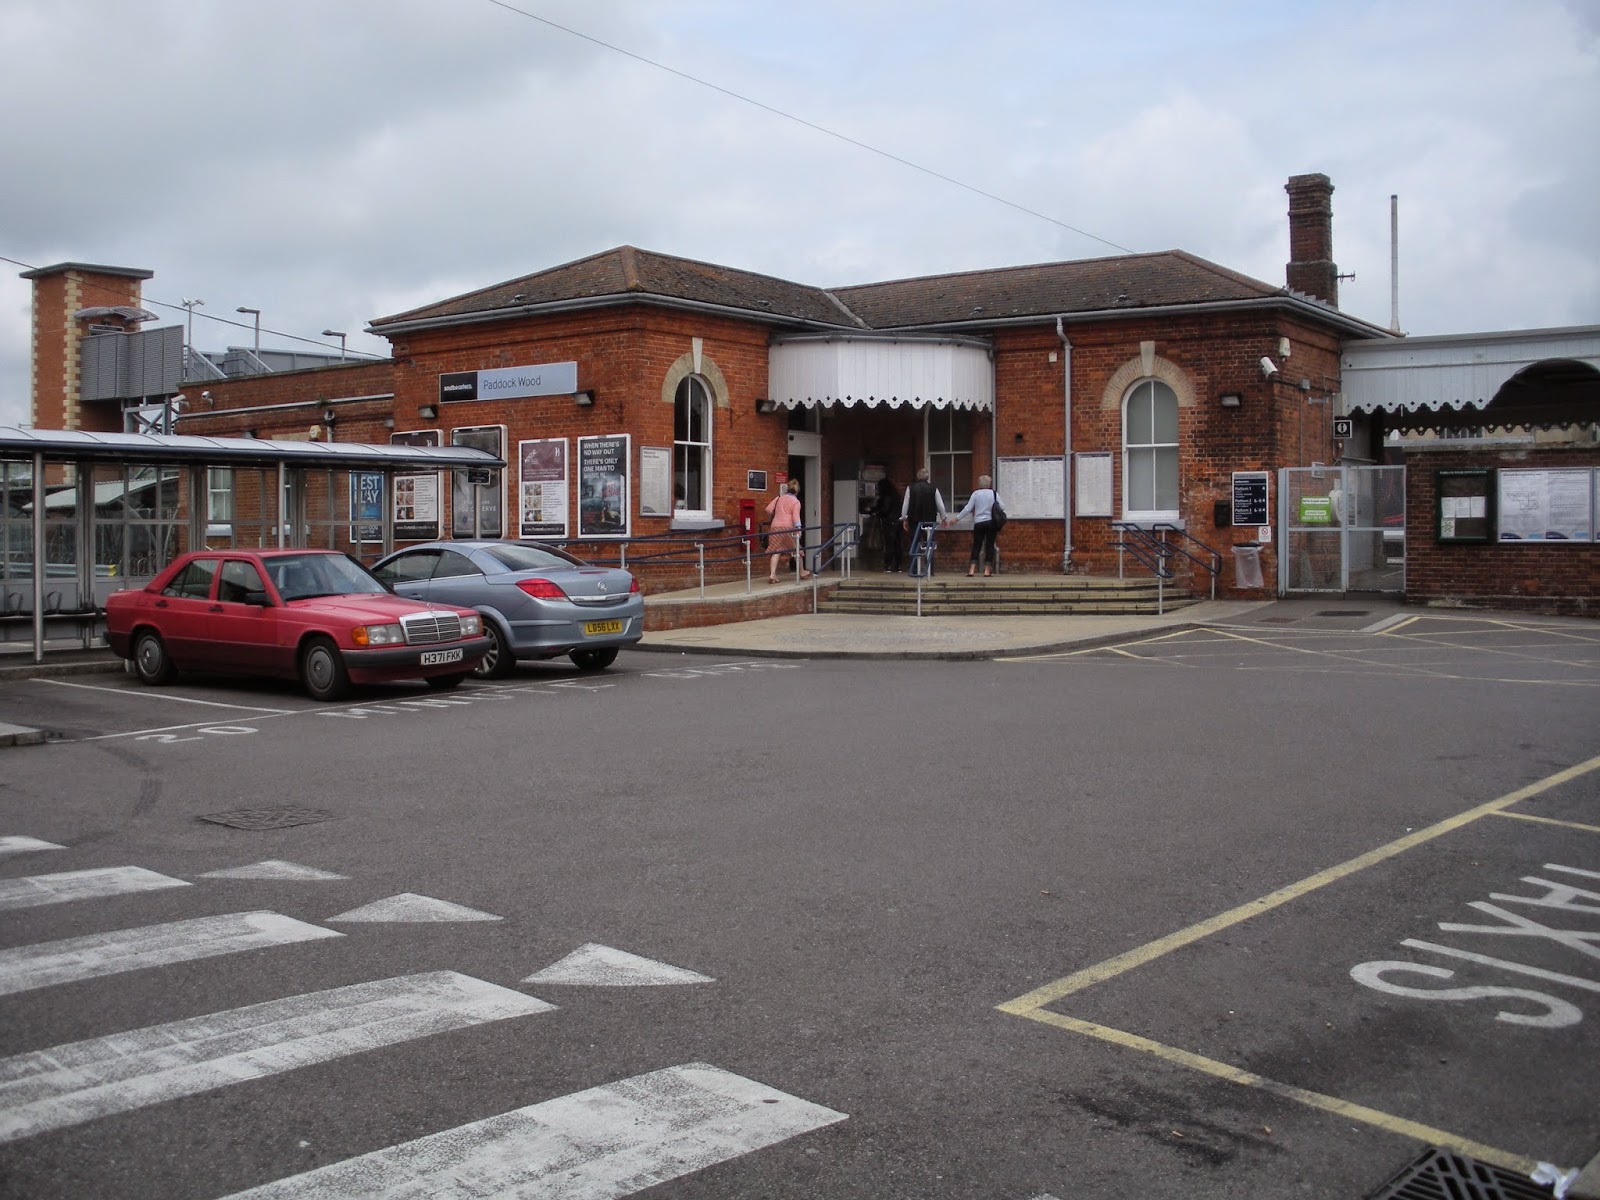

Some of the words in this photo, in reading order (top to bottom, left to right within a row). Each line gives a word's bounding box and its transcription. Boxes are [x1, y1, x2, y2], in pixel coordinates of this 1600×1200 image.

[483, 378, 517, 390] Paddock
[518, 375, 541, 387] Wood
[606, 621, 620, 631] LXX
[424, 652, 445, 663] H371
[446, 649, 461, 661] FKK
